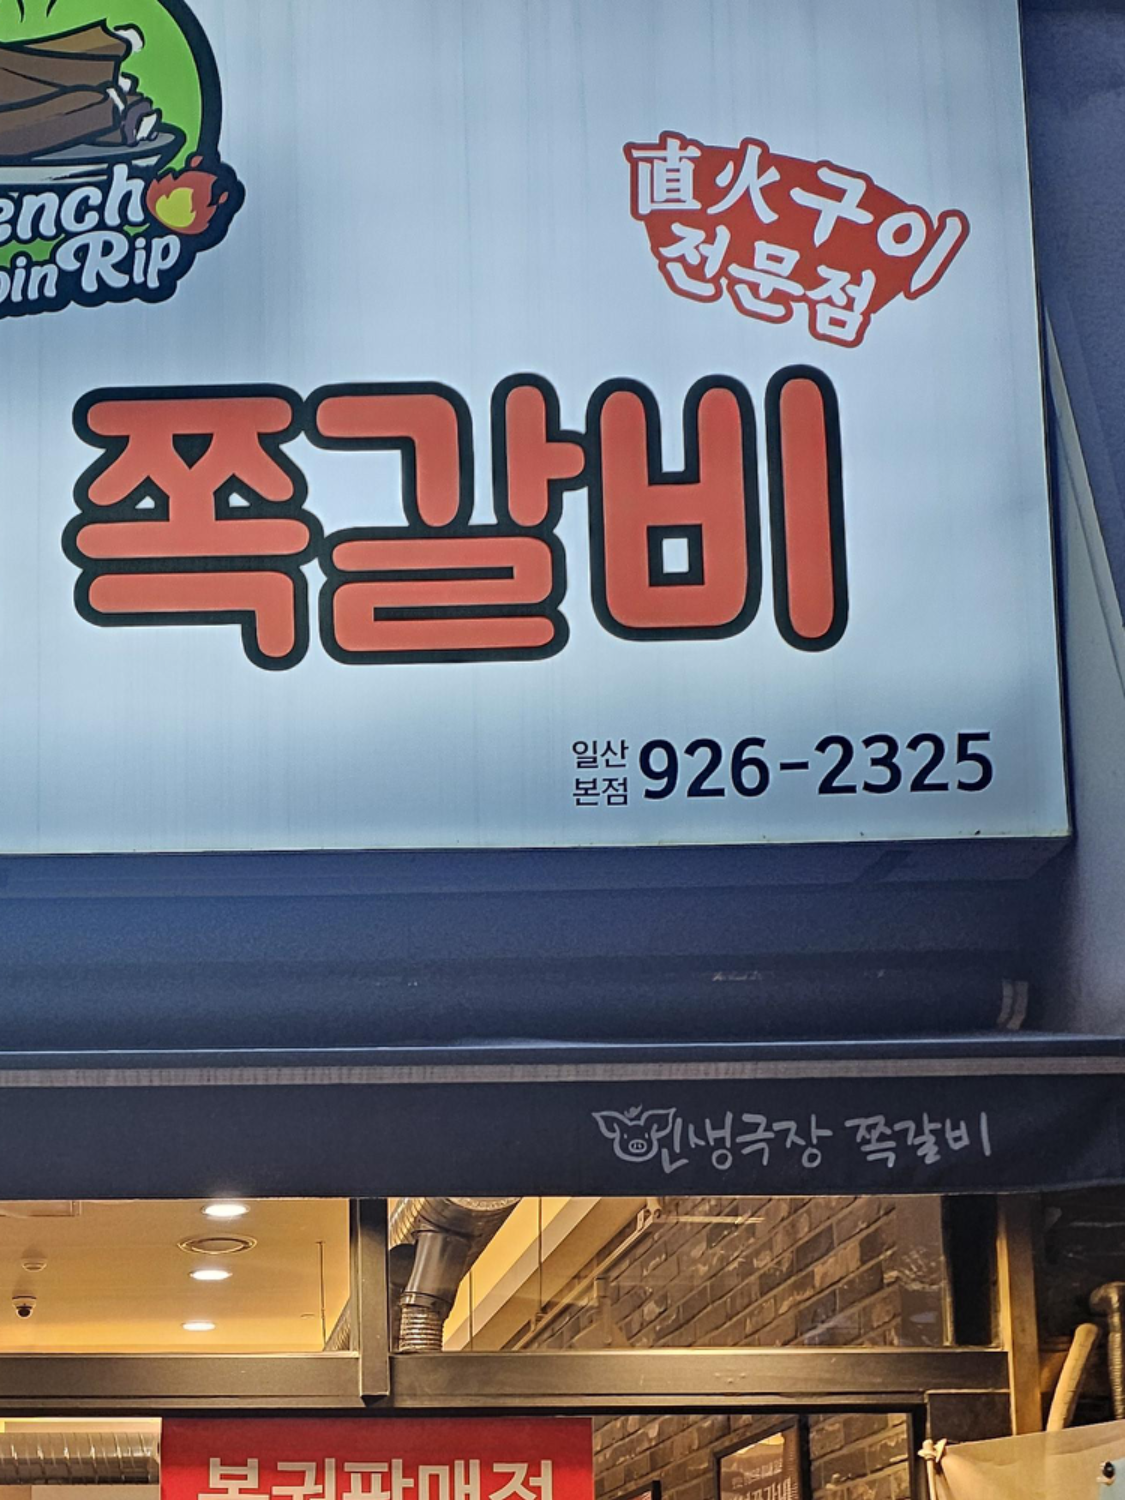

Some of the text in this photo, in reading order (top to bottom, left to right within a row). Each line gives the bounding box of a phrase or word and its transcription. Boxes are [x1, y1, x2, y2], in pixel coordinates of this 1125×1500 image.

[56, 231, 181, 293] Rip
[659, 222, 876, 344] 전문점
[61, 364, 849, 671] 쪽갈비
[572, 739, 629, 769] 일산
[638, 731, 994, 800] 926-2325
[572, 776, 629, 807] 본점
[844, 1111, 992, 1168] 쪽갈비
